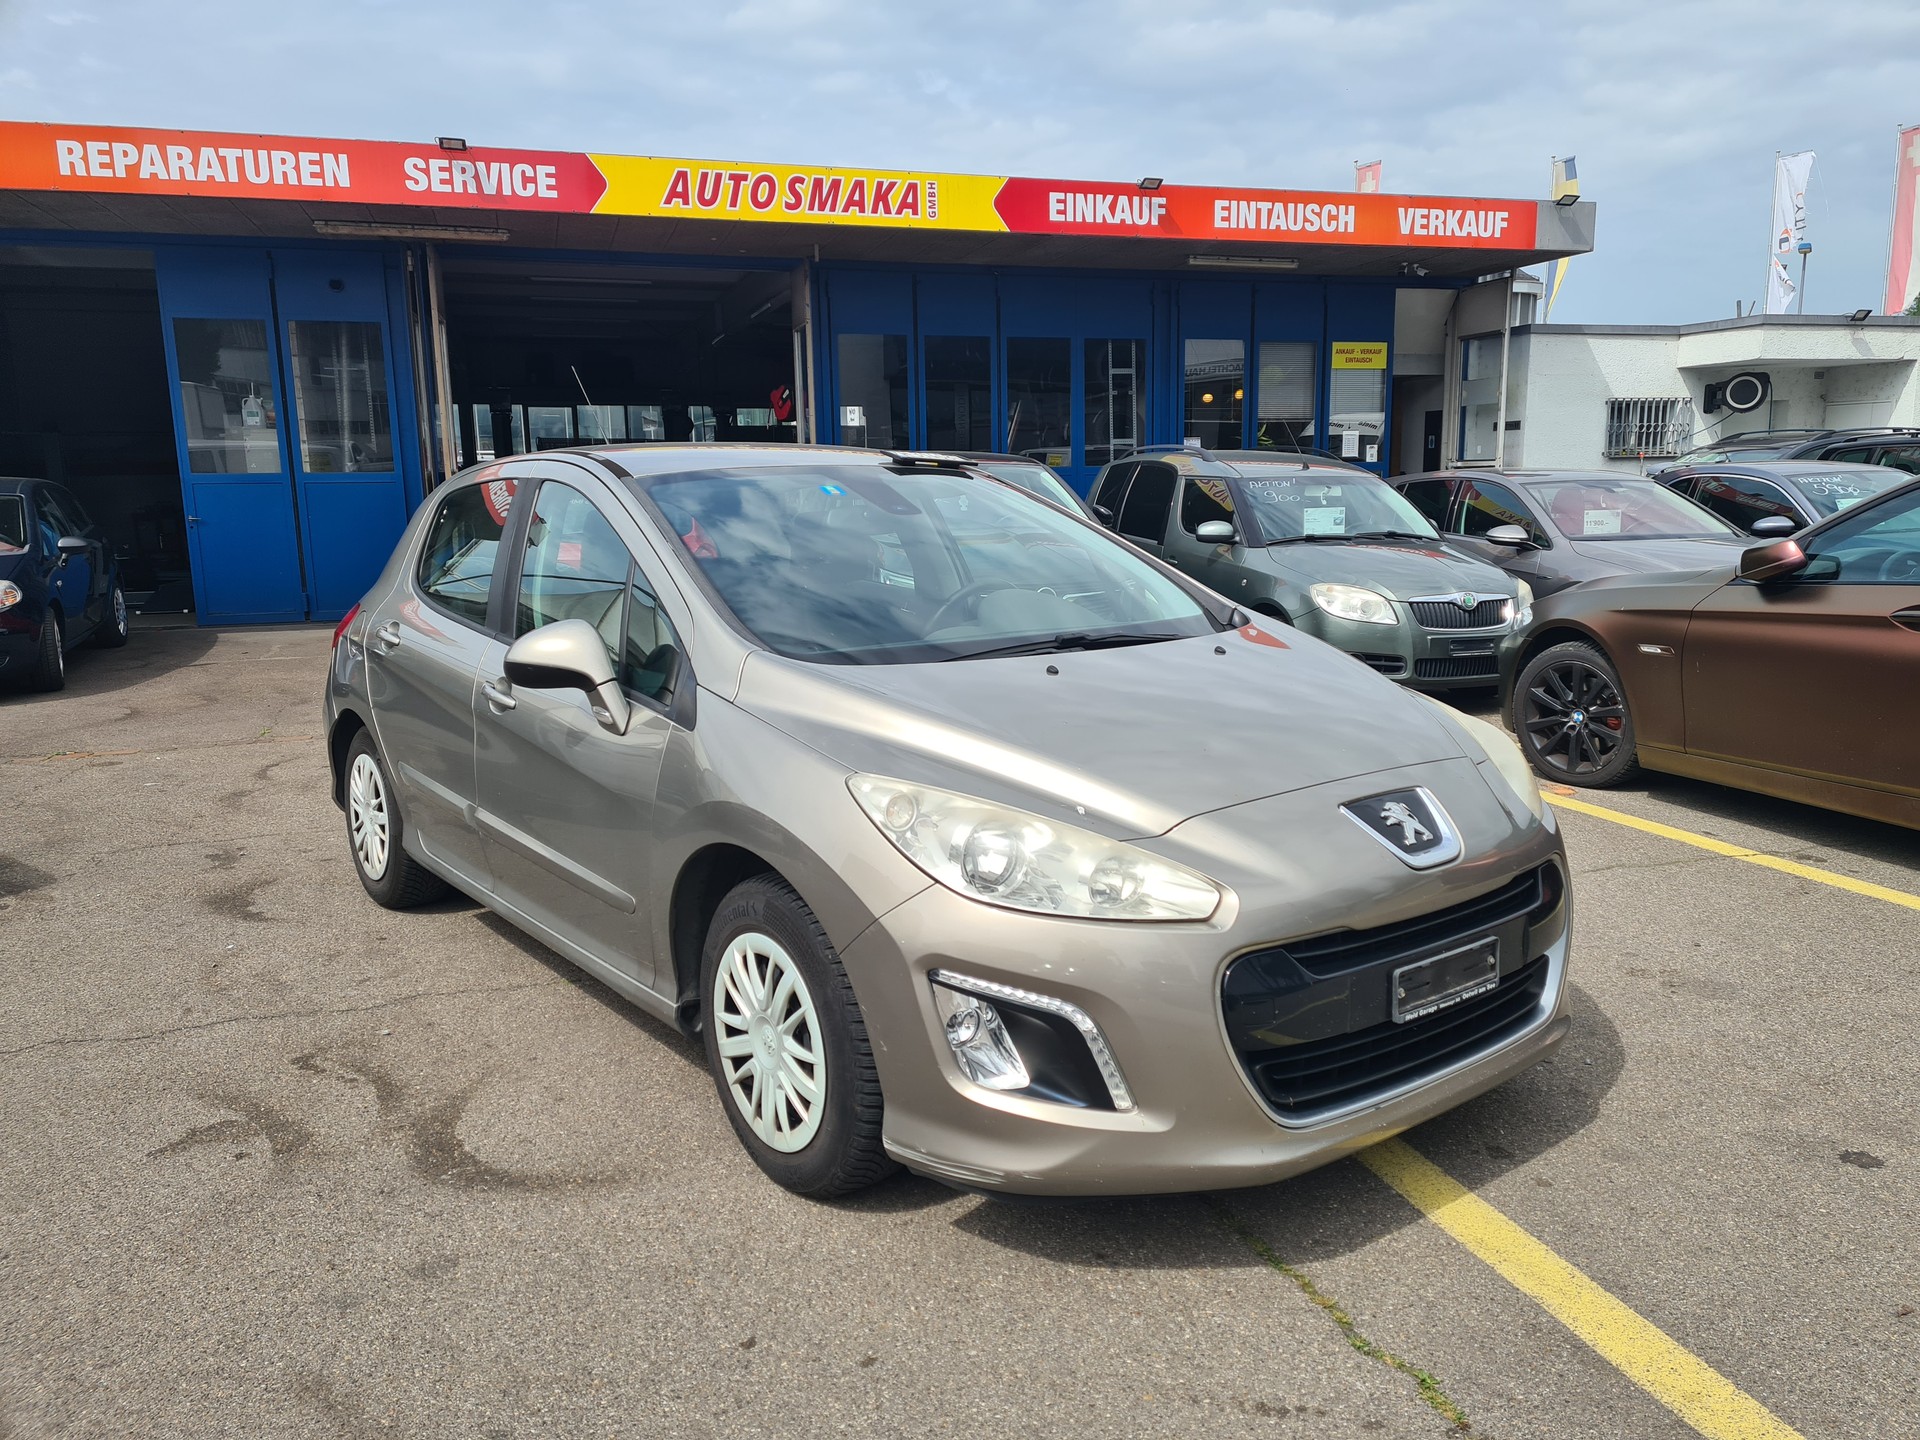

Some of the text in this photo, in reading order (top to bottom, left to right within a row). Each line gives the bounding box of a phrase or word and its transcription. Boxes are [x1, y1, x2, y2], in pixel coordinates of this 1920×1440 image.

[56, 140, 350, 188] REPARATUREN
[404, 156, 558, 198] SERVICE
[661, 168, 921, 218] AUTO SMAKA
[927, 181, 938, 219] GMBH
[1049, 192, 1166, 226] EINKAUF
[1213, 199, 1355, 233] EINTAUSCH
[1398, 207, 1509, 238] VERKAUF
[1419, 1006, 1438, 1017] Garage
